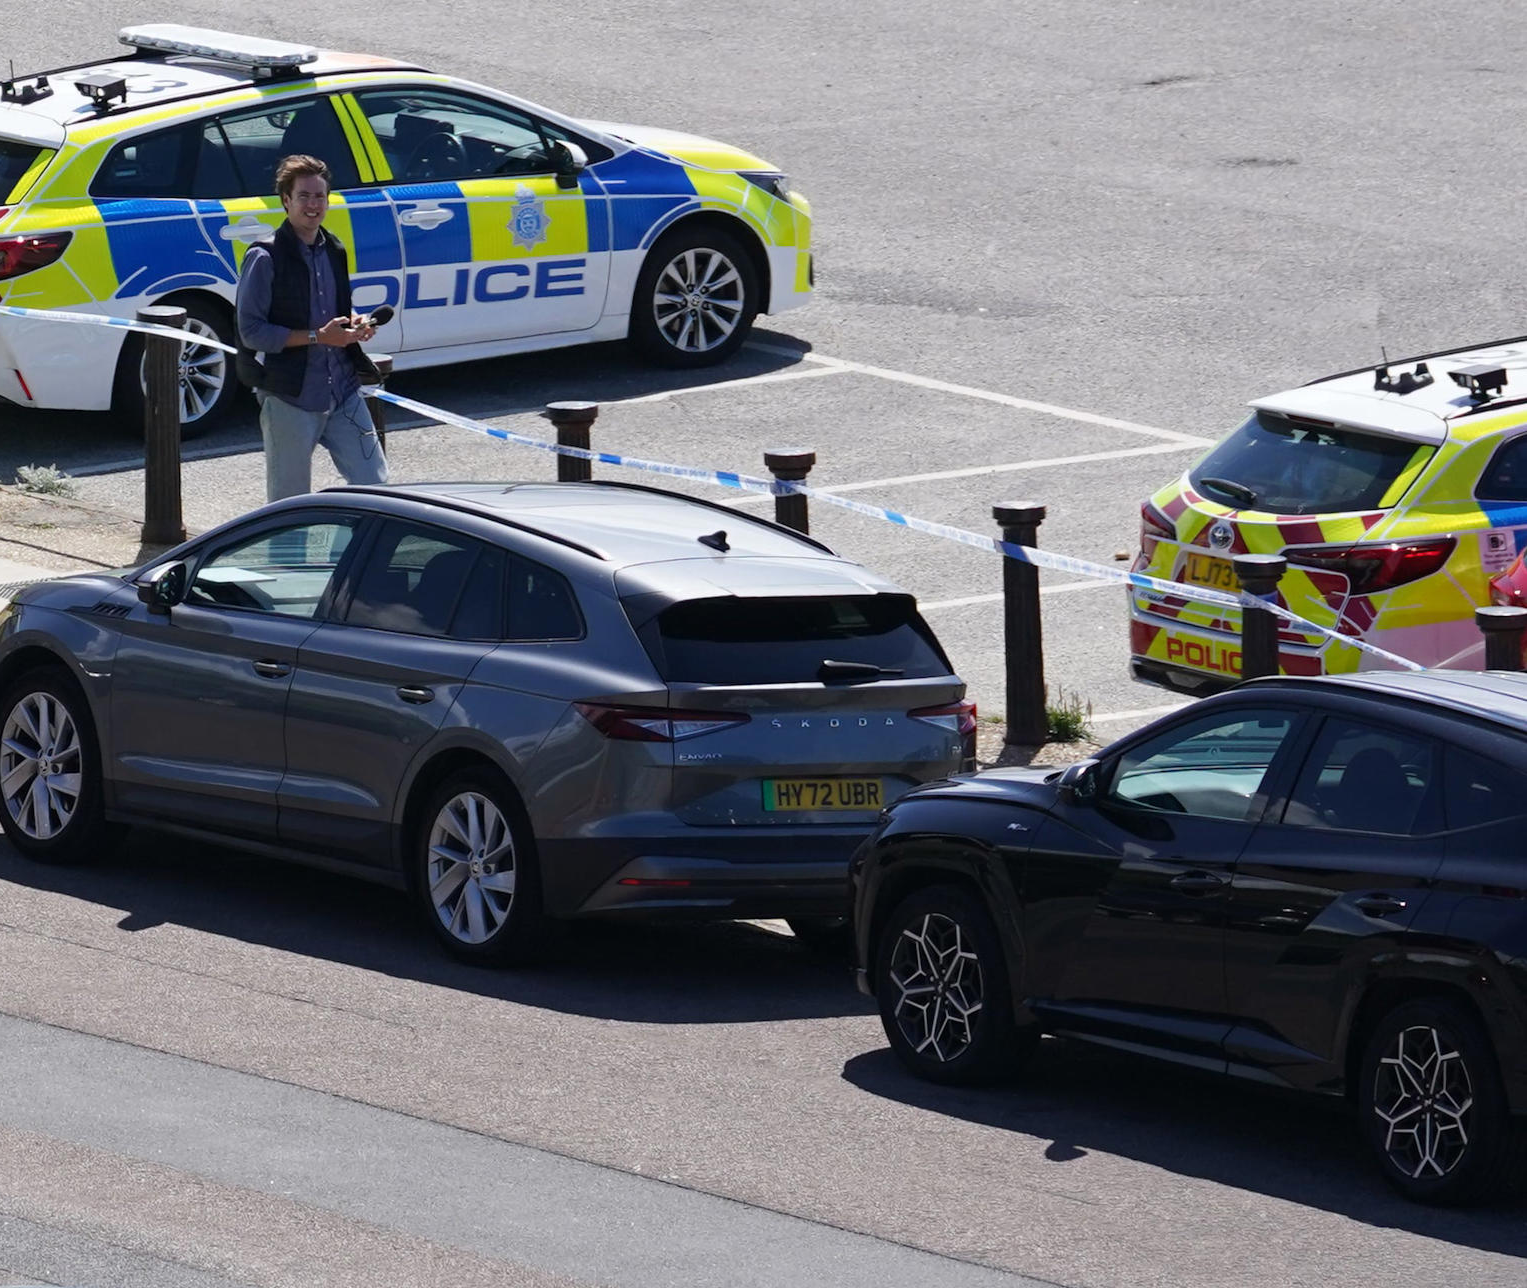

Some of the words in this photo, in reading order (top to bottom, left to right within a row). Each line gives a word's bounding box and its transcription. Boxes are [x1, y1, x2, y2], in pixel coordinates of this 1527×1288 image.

[1192, 558, 1232, 587] LJ73
[777, 783, 834, 807] HY72
[839, 782, 880, 805] UBR
